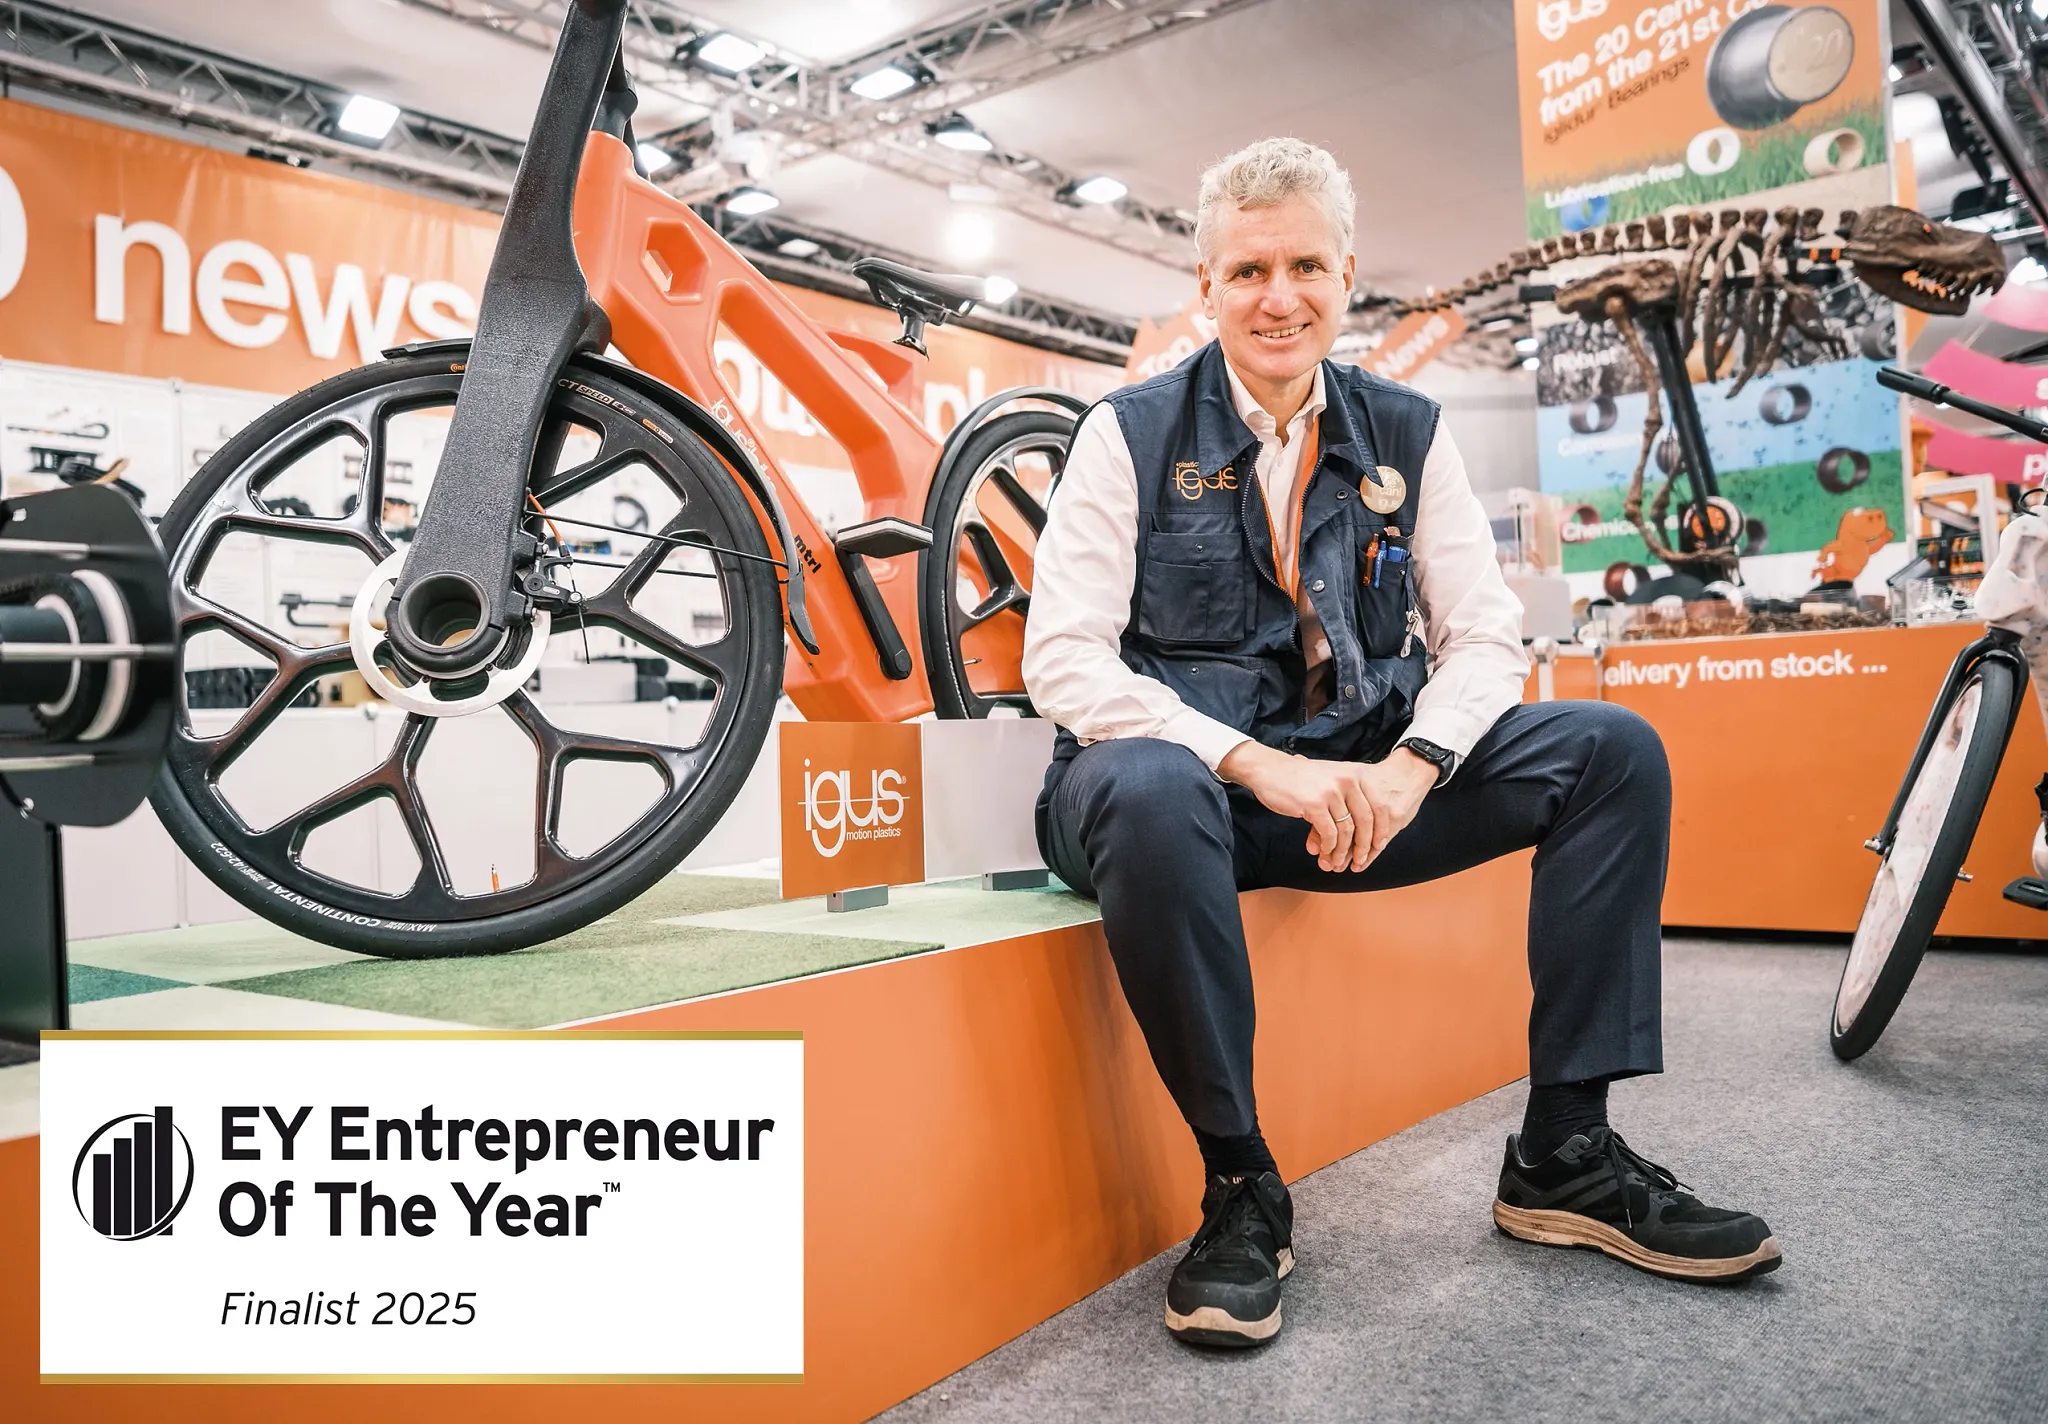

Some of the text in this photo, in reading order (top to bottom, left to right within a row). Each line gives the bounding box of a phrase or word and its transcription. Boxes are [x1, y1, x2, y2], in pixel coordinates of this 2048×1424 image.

[1537, 53, 1590, 94] The
[1595, 24, 1630, 66] 20
[1540, 76, 1603, 126] from
[1607, 48, 1654, 88] the
[1658, 6, 1721, 62] 21st
[94, 212, 481, 366] news
[577, 384, 614, 404] SPEED
[1604, 659, 1692, 689] elivery
[1697, 655, 1763, 682] from
[1770, 648, 1855, 679] stock
[846, 826, 902, 841] motion plastics
[265, 881, 382, 927] CONTINENTAL
